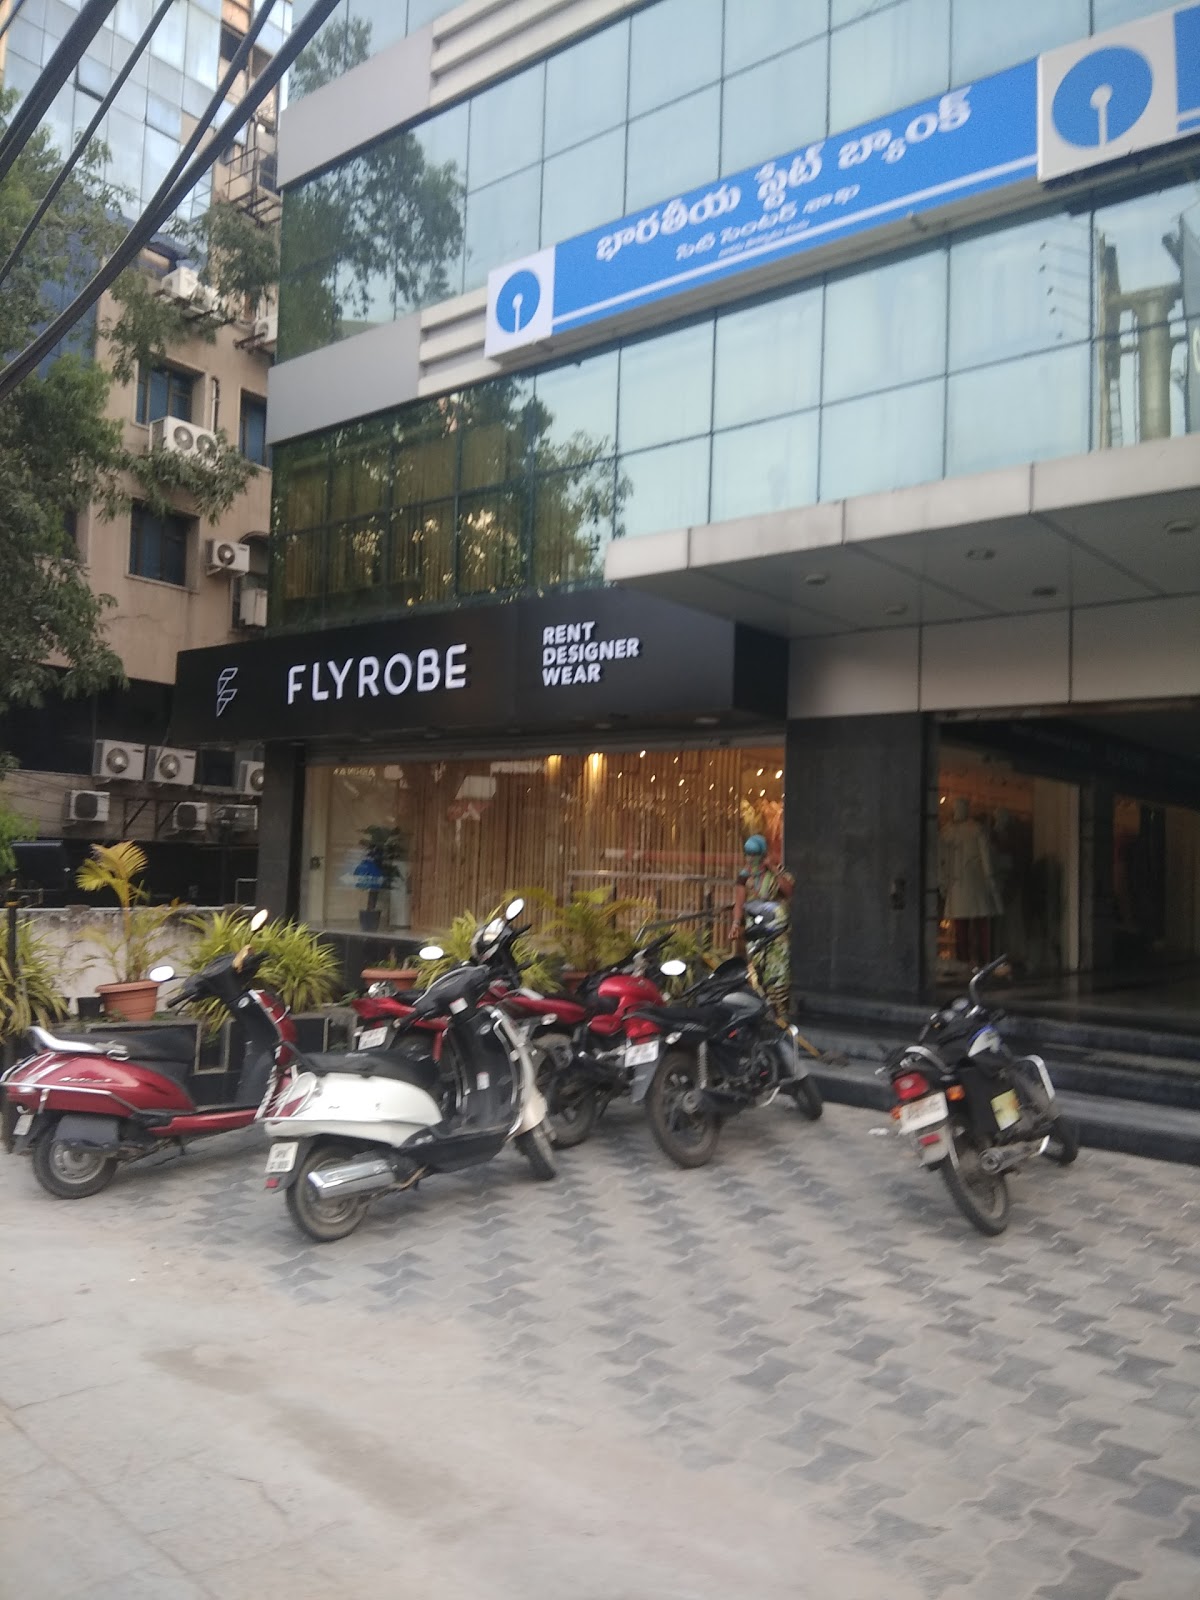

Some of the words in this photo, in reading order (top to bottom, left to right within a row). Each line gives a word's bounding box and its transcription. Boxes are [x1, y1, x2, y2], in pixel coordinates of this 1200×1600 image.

[596, 184, 741, 261] భారతీయ
[542, 620, 596, 646] RENT
[542, 637, 640, 665] DESIGNER
[287, 643, 468, 705] FLYROBE
[542, 664, 601, 687] WEAR
